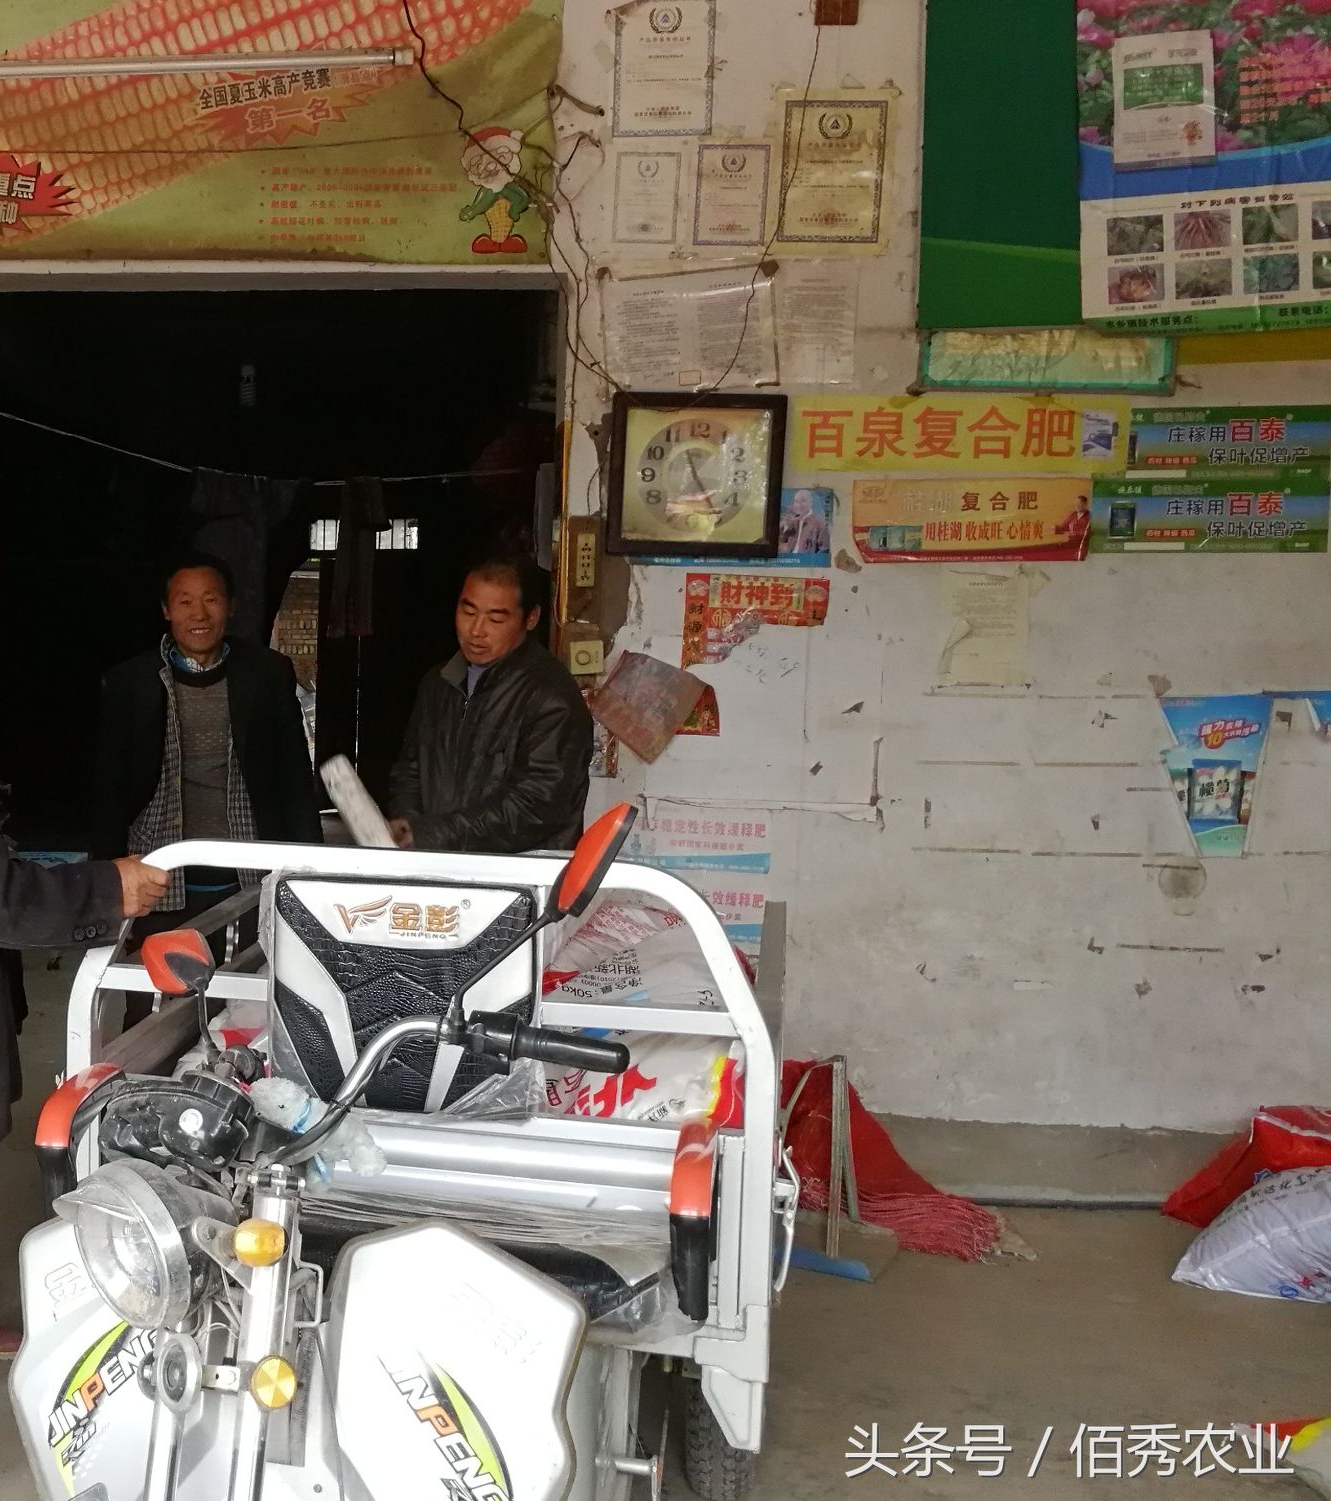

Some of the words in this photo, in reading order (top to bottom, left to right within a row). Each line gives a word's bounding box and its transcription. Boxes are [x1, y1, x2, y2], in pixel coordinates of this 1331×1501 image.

[200, 68, 331, 110] 全国夏玉米高产竞赛
[246, 97, 332, 133] 第一名
[690, 422, 711, 438] 12
[801, 406, 1076, 460] 百泉复合肥
[1168, 416, 1287, 443] 庄稼用百泰
[646, 446, 664, 461] 10
[730, 447, 745, 461] 2
[1208, 446, 1310, 466] 保叶促增产
[641, 467, 655, 483] 9
[734, 469, 747, 485] 3
[646, 489, 661, 505] 8
[724, 491, 740, 506] 4
[961, 491, 1039, 512] 复合肥
[1166, 491, 1284, 516] 庄稼用百泰
[925, 521, 962, 542] 用桂湖
[965, 521, 1003, 542] 收成旺
[1006, 520, 1044, 541] 心情爽
[1207, 520, 1308, 538] 保叶促增产
[721, 581, 794, 606] 財神到
[389, 902, 459, 932] 金彭
[400, 931, 448, 940] JINPENG
[48, 1329, 157, 1448] JINPENG
